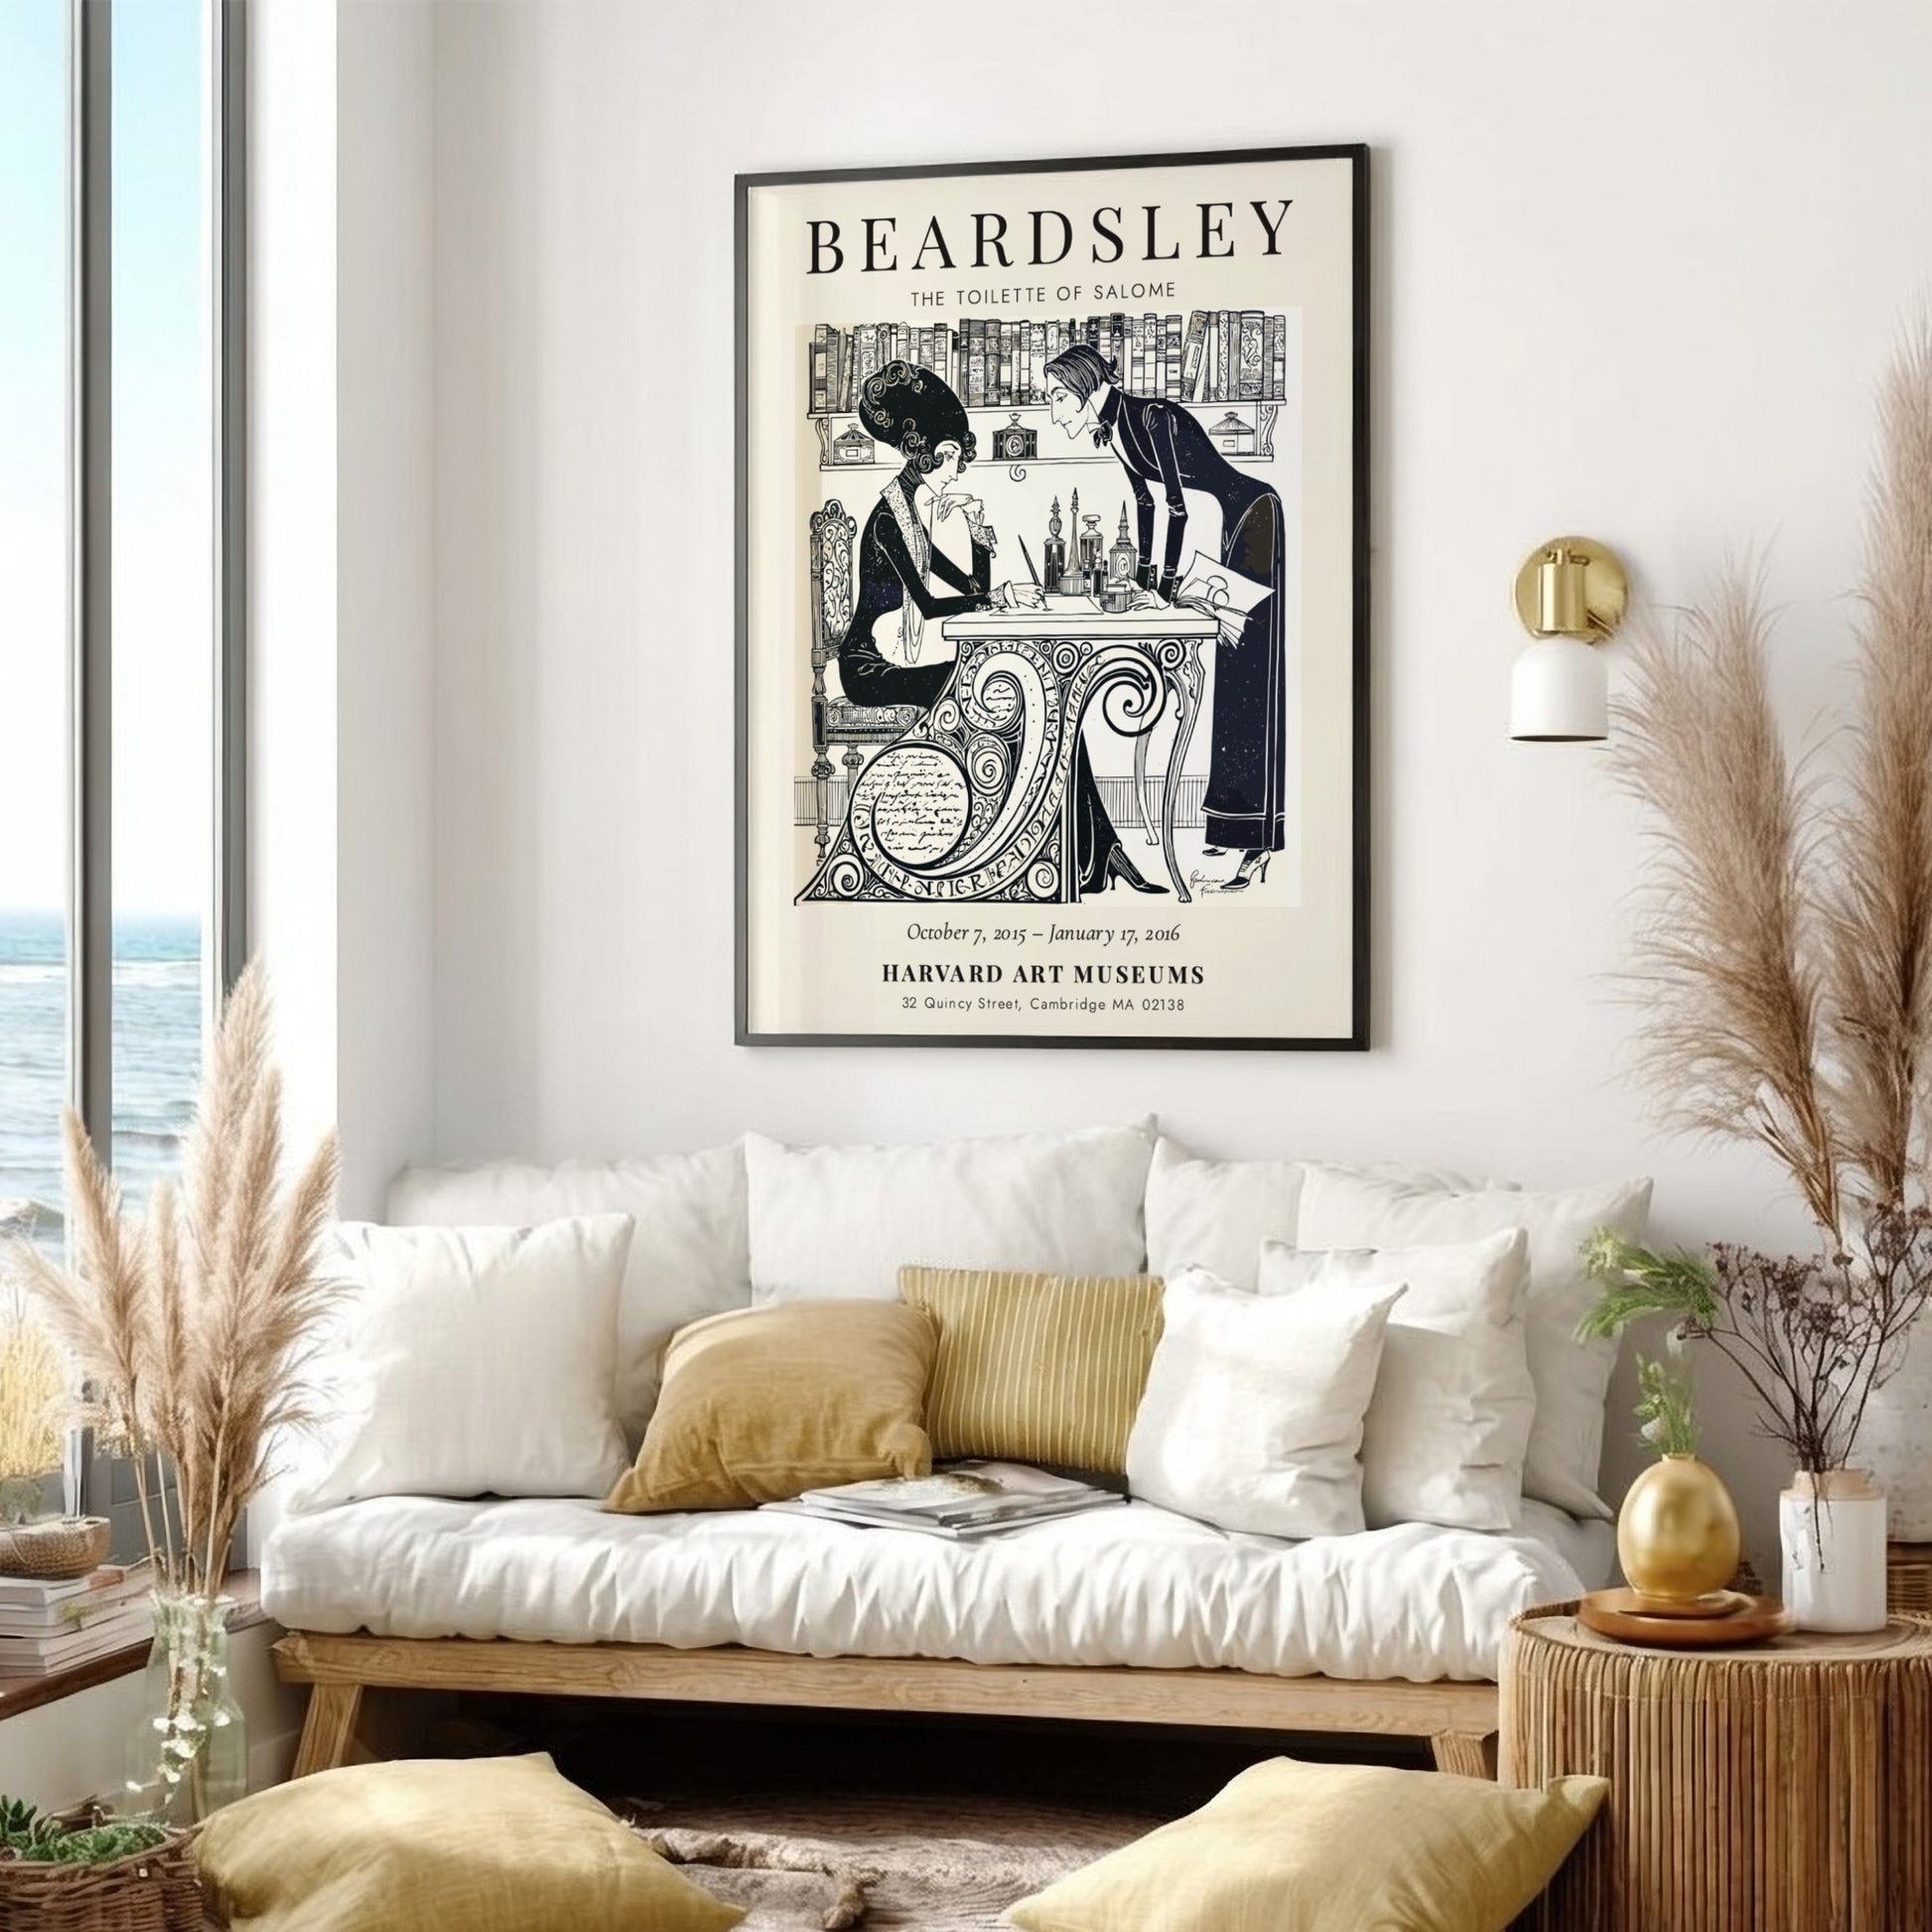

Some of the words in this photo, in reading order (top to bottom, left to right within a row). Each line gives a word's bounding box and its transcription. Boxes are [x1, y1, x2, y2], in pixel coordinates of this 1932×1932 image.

[805, 199, 1294, 275] BEARDSLEY
[910, 291, 945, 307] THE
[956, 287, 1045, 306] TOILETTE
[1056, 285, 1082, 302] OF
[1093, 281, 1175, 300] SALOME
[906, 921, 970, 940] October
[973, 928, 987, 946] 7,
[993, 928, 1028, 946] 2015
[1047, 923, 1115, 947] January
[1120, 929, 1139, 947] 17,
[1145, 923, 1181, 941] 2016
[882, 963, 1003, 984] HARVARD
[1012, 964, 1064, 984] ART
[1073, 965, 1204, 985] MUSEUMS
[901, 996, 917, 1009] 32
[923, 996, 973, 1013] Quincy
[978, 997, 1022, 1012] Street,
[1030, 997, 1106, 1014] Cambridge
[1112, 998, 1135, 1011] MA
[1142, 998, 1184, 1012] 02138
